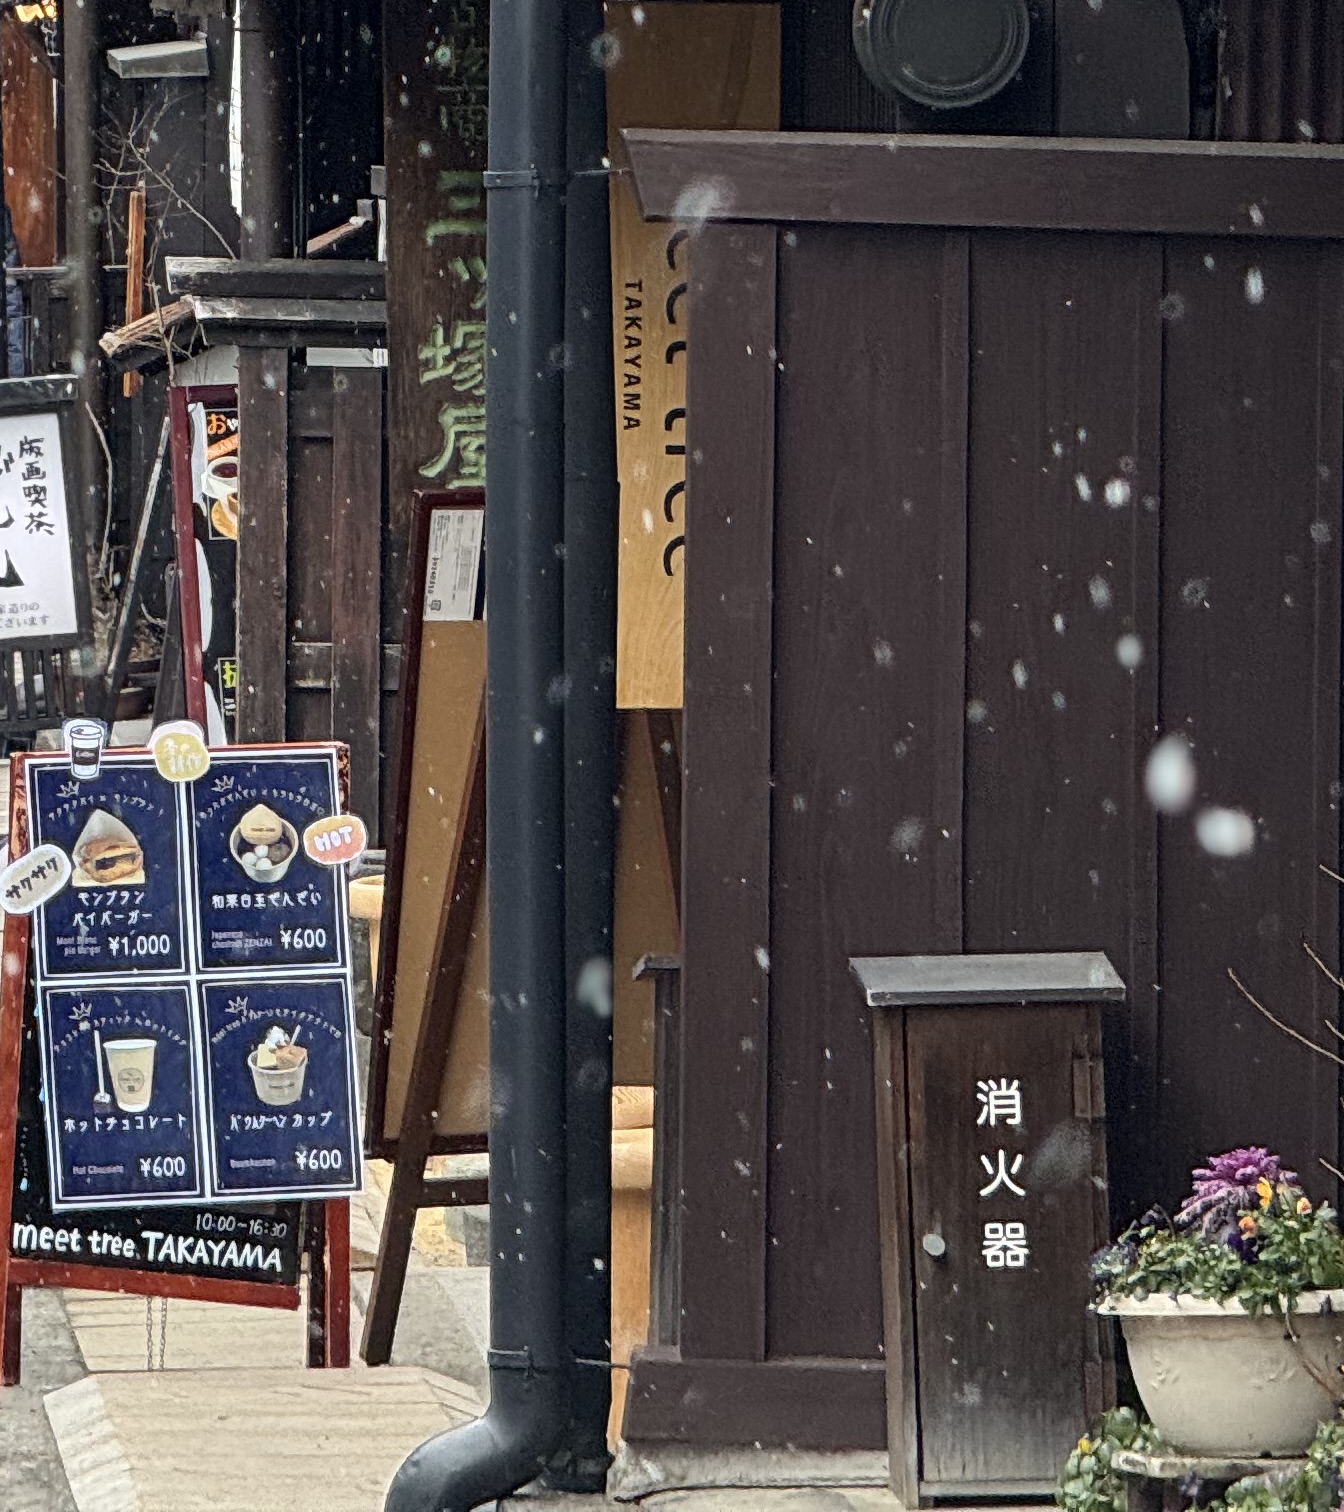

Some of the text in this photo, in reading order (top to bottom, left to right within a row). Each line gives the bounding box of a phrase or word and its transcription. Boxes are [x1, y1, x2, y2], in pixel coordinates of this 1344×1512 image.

[623, 279, 643, 431] TAKAYAMA
[18, 435, 55, 536] 版画喫茶
[313, 825, 353, 852] HOT
[77, 889, 145, 907] モンブラン
[108, 934, 171, 957] ¥1,000
[280, 927, 327, 949] ¥600
[139, 1155, 186, 1178] ¥600
[295, 1148, 342, 1170] ¥600
[976, 1078, 1030, 1268] 消火器
[12, 1221, 81, 1252] meet
[141, 1230, 283, 1273] TAKAYAMA
